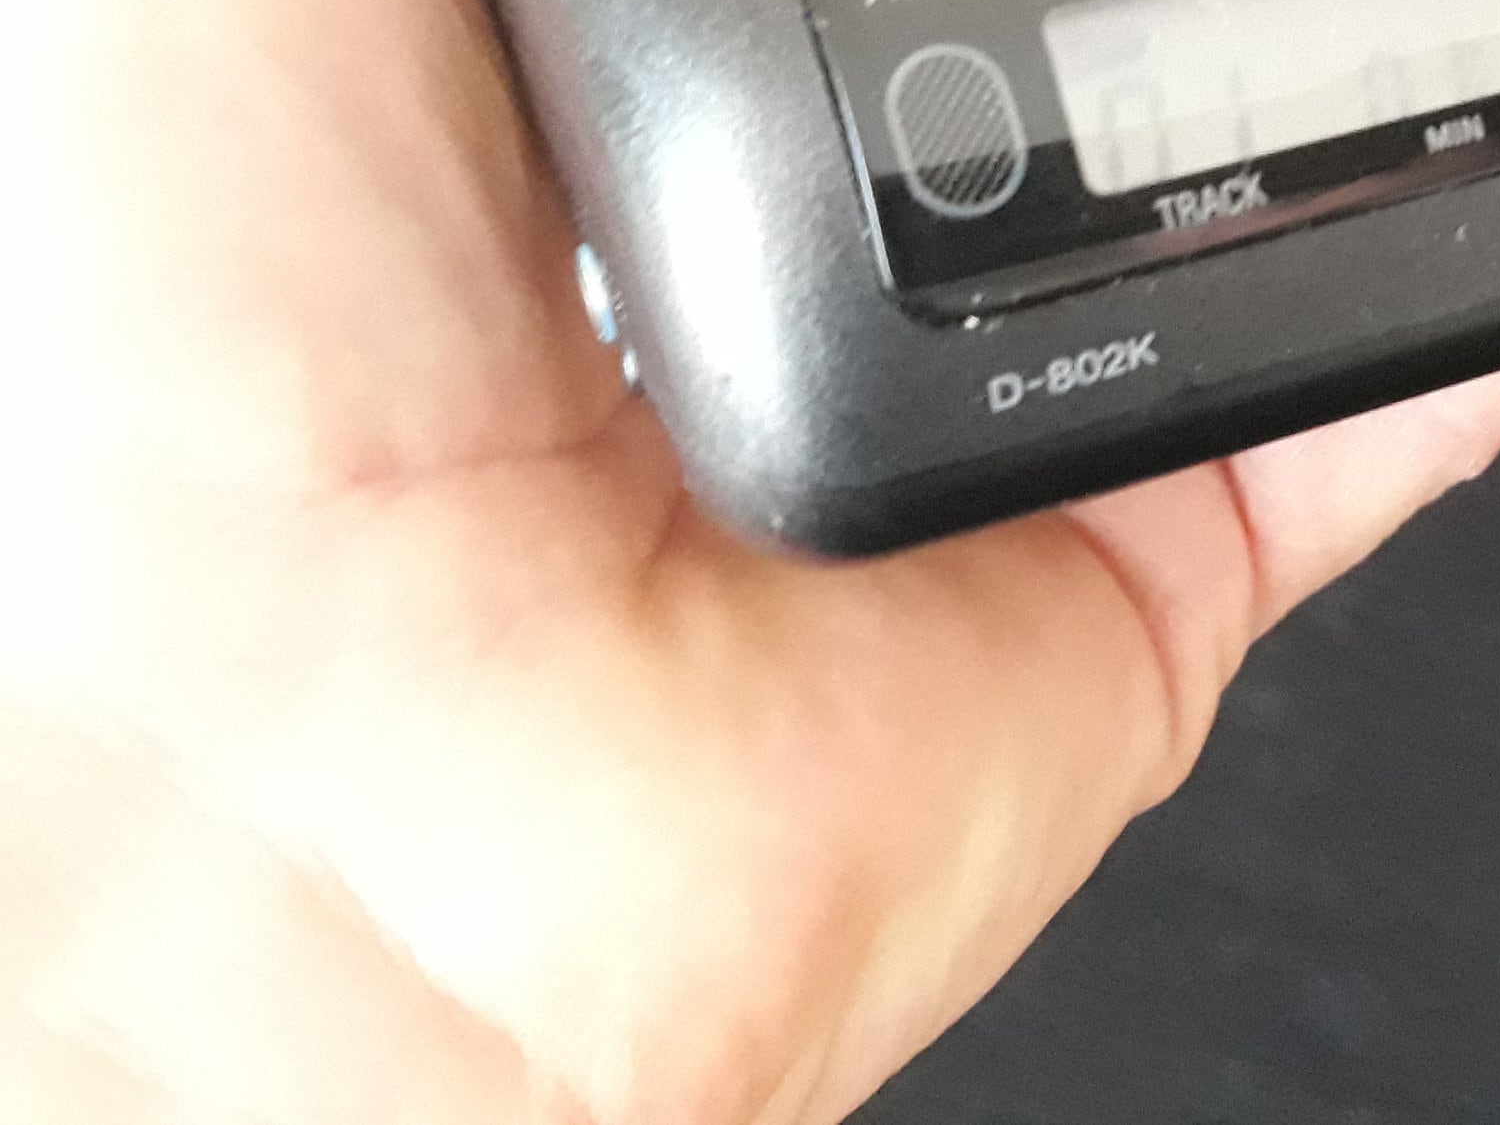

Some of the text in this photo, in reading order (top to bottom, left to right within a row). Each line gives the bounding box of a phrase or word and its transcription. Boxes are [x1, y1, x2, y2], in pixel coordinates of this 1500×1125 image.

[1424, 112, 1486, 156] MIN
[1152, 169, 1269, 233] TRACK
[987, 331, 1159, 414] D-802K
